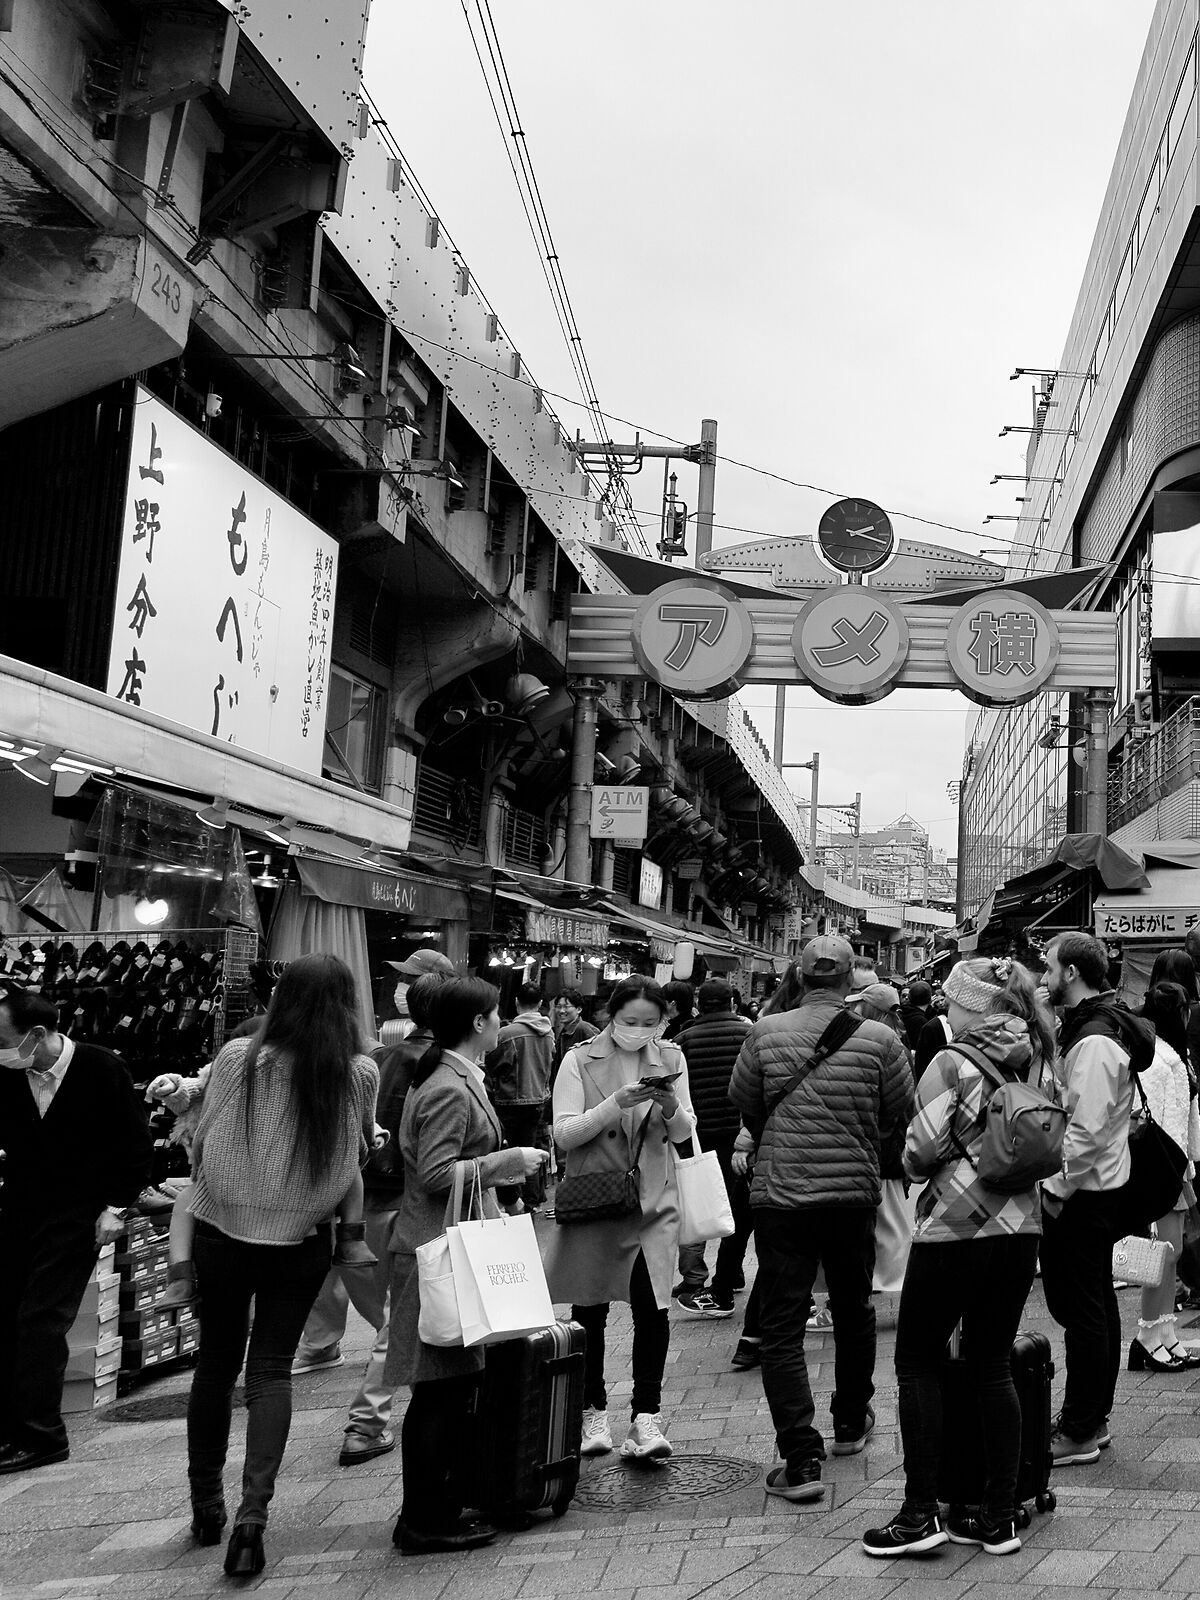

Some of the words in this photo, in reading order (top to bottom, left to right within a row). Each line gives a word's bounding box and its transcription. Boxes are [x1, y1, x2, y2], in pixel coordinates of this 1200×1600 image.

[151, 262, 181, 314] 243
[115, 421, 165, 708] 上野分店
[600, 791, 644, 806] ATM
[1105, 915, 1176, 933] たらばがに
[486, 1262, 526, 1276] FERRERO
[489, 1272, 529, 1287] ROCHER
